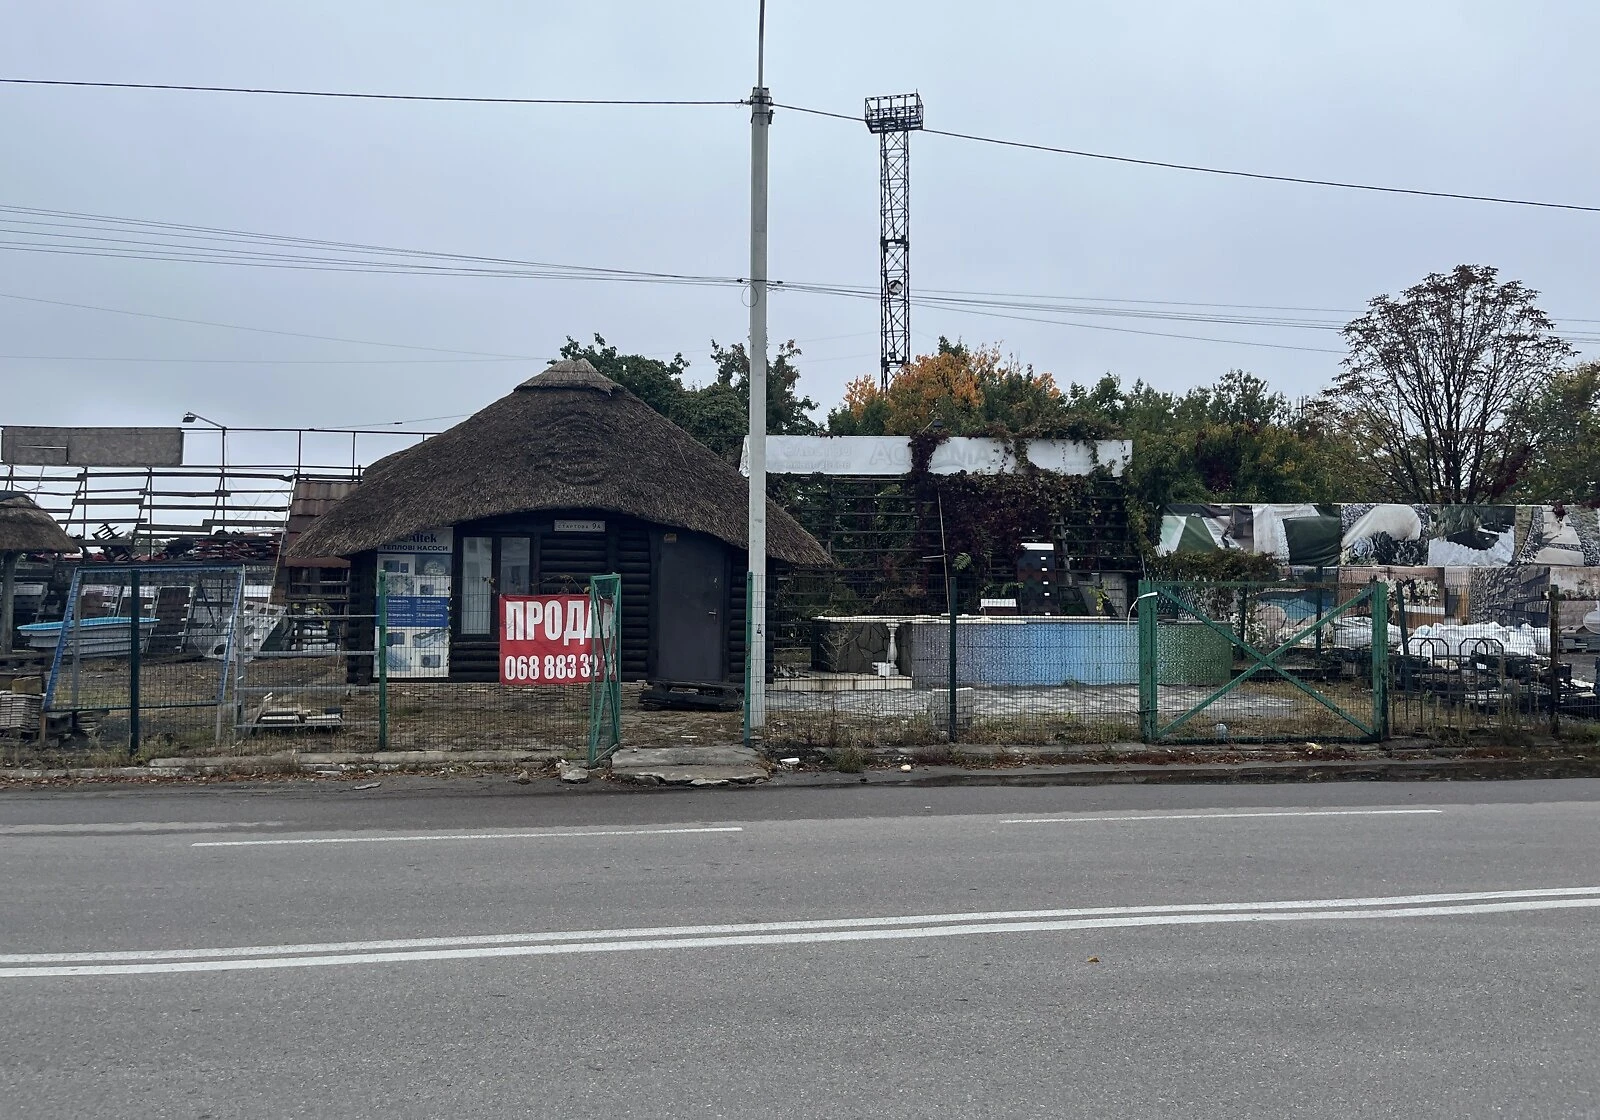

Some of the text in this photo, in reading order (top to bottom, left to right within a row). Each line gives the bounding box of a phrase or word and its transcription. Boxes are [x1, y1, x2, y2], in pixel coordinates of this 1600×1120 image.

[417, 544, 448, 552] НАСОСИ
[504, 655, 540, 680] 068
[544, 654, 577, 679] 883
[580, 653, 600, 678] 32
